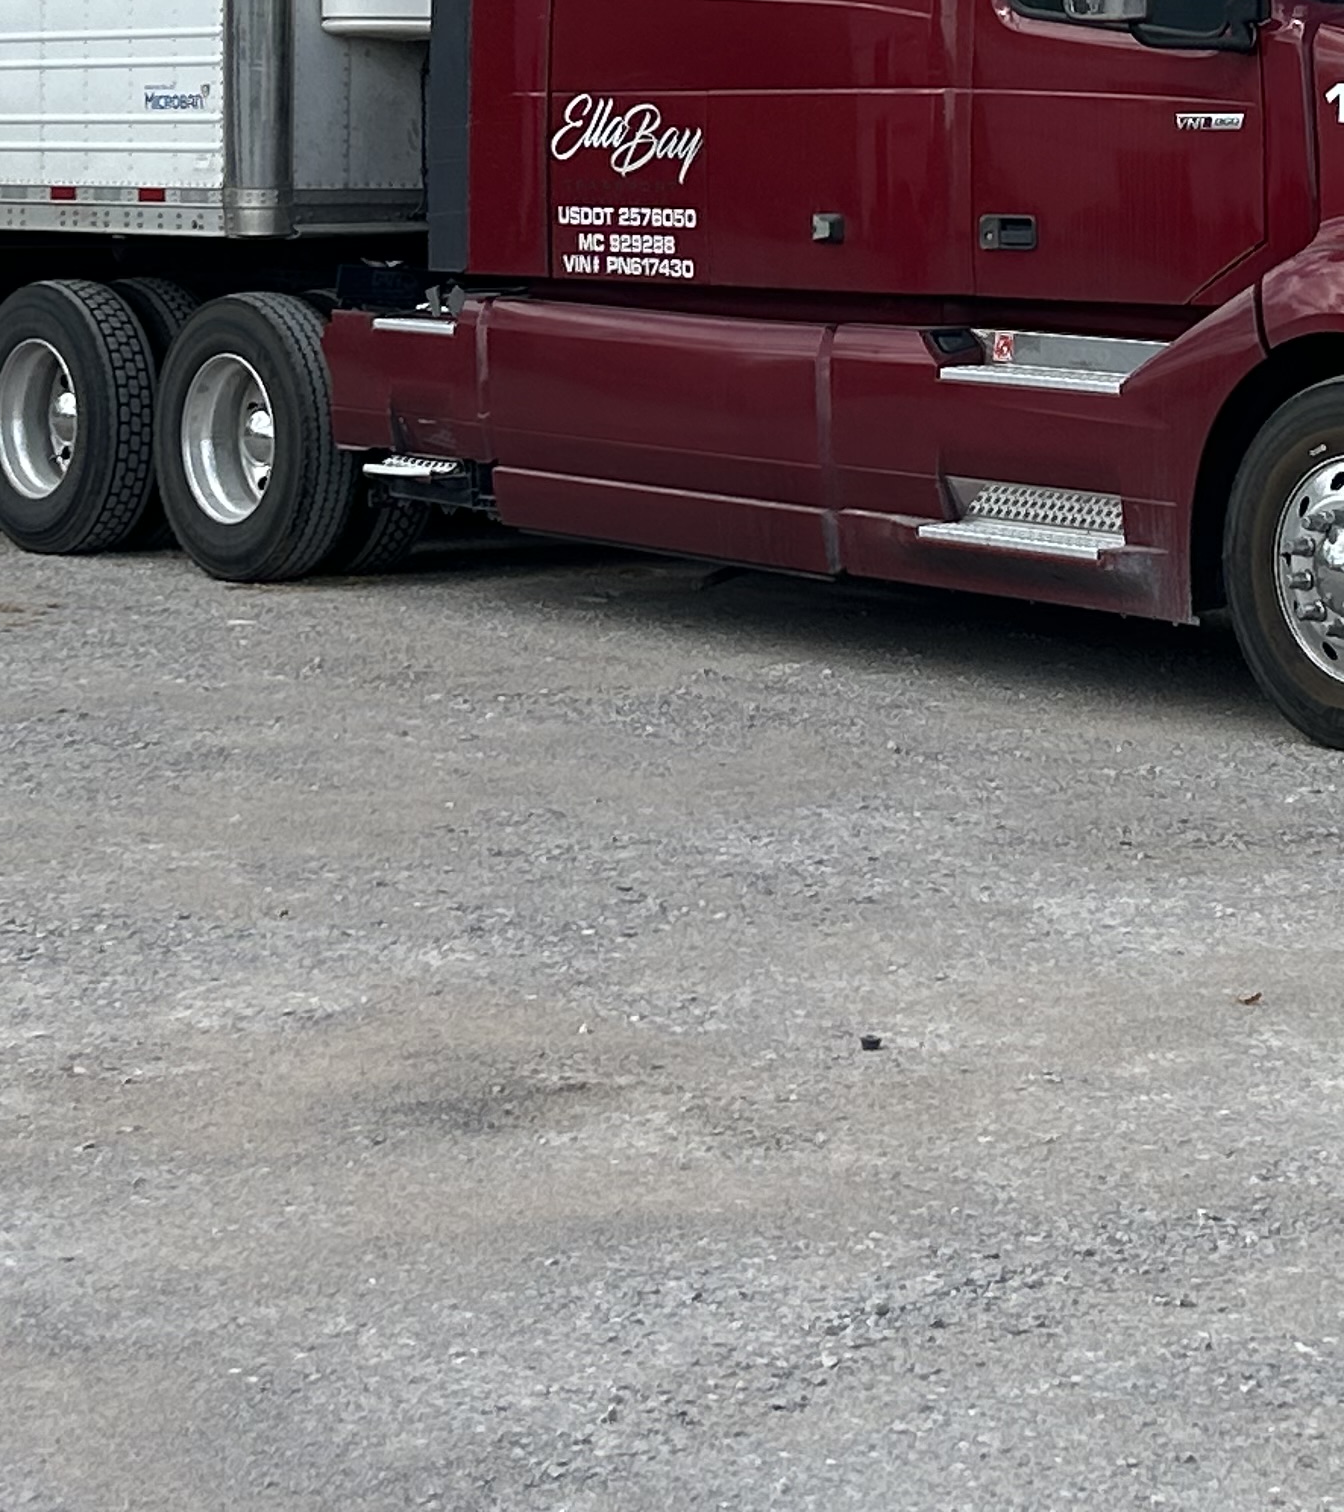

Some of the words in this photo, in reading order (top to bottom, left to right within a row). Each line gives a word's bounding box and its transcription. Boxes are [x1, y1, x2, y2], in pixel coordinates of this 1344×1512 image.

[558, 206, 614, 226] USDOT
[618, 207, 697, 229] 2576050
[578, 233, 605, 252] MC
[609, 234, 676, 254] 929288
[606, 256, 695, 279] PN617430
